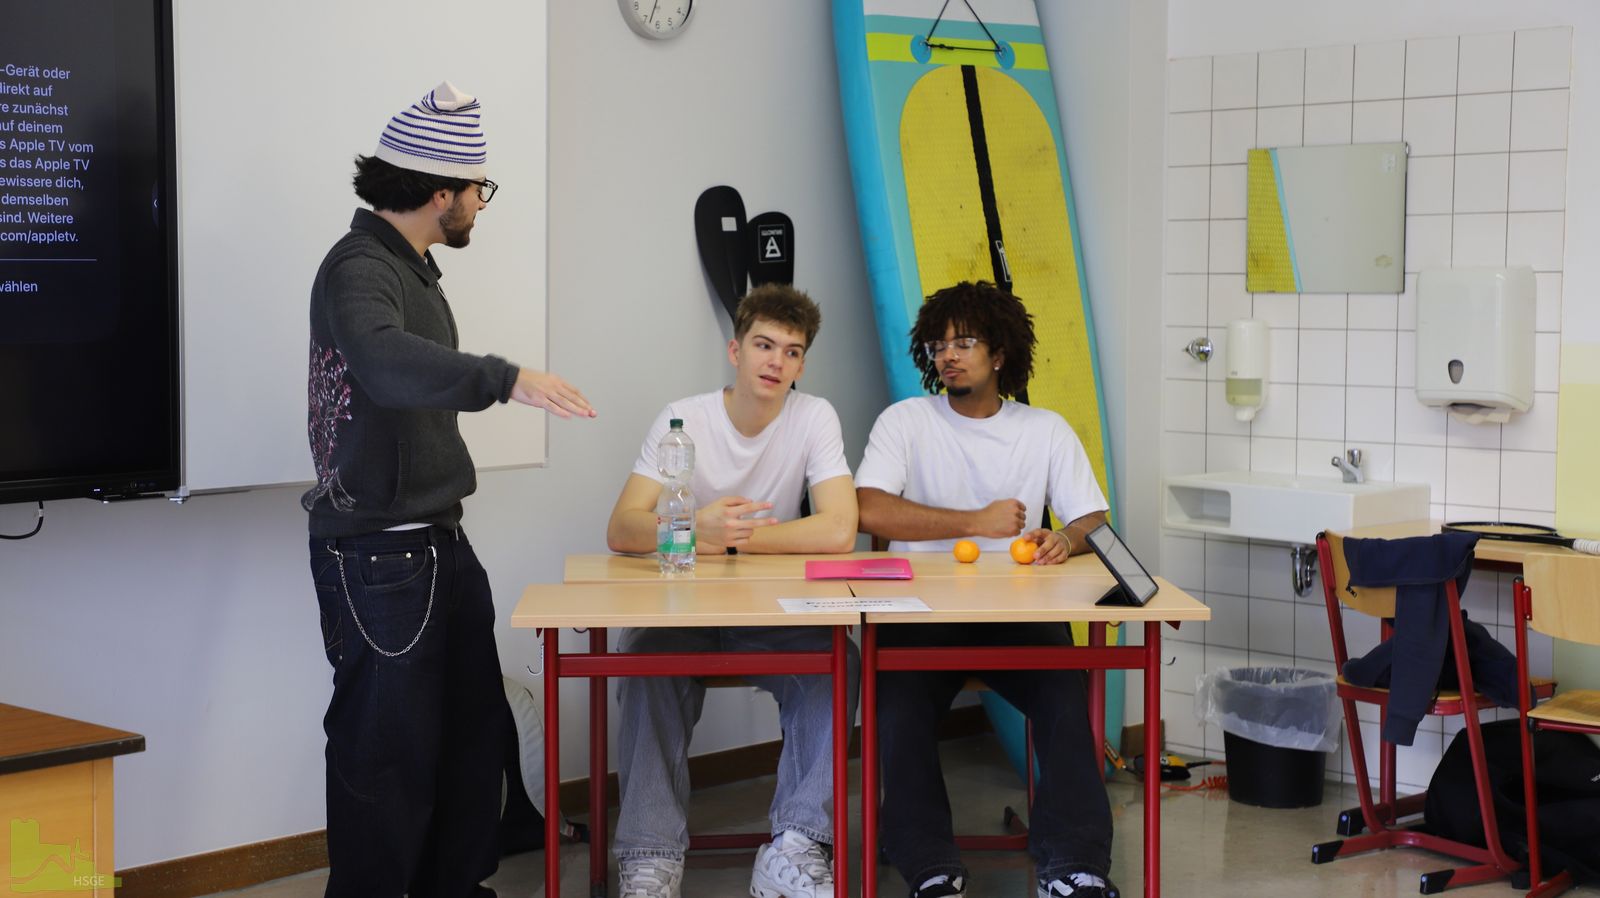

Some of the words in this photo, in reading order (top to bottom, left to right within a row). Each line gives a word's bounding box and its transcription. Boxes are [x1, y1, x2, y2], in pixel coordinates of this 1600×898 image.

[643, 14, 648, 24] 7
[655, 20, 660, 29] 6
[667, 17, 672, 26] 5
[43, 67, 71, 79] oder
[33, 85, 53, 96] auf
[12, 103, 68, 116] zunächst
[0, 120, 15, 131] uf
[18, 121, 63, 133] deinem
[9, 138, 46, 153] Apple
[48, 139, 66, 152] TV
[68, 143, 94, 153] vom
[9, 157, 32, 169] das
[35, 157, 71, 172] Apple
[73, 158, 90, 171] TV
[0, 175, 53, 188] ewissere
[55, 176, 84, 191] dich,
[1, 193, 69, 206] demselben
[27, 211, 74, 224] Weitere
[0, 229, 79, 244] com/appletv.
